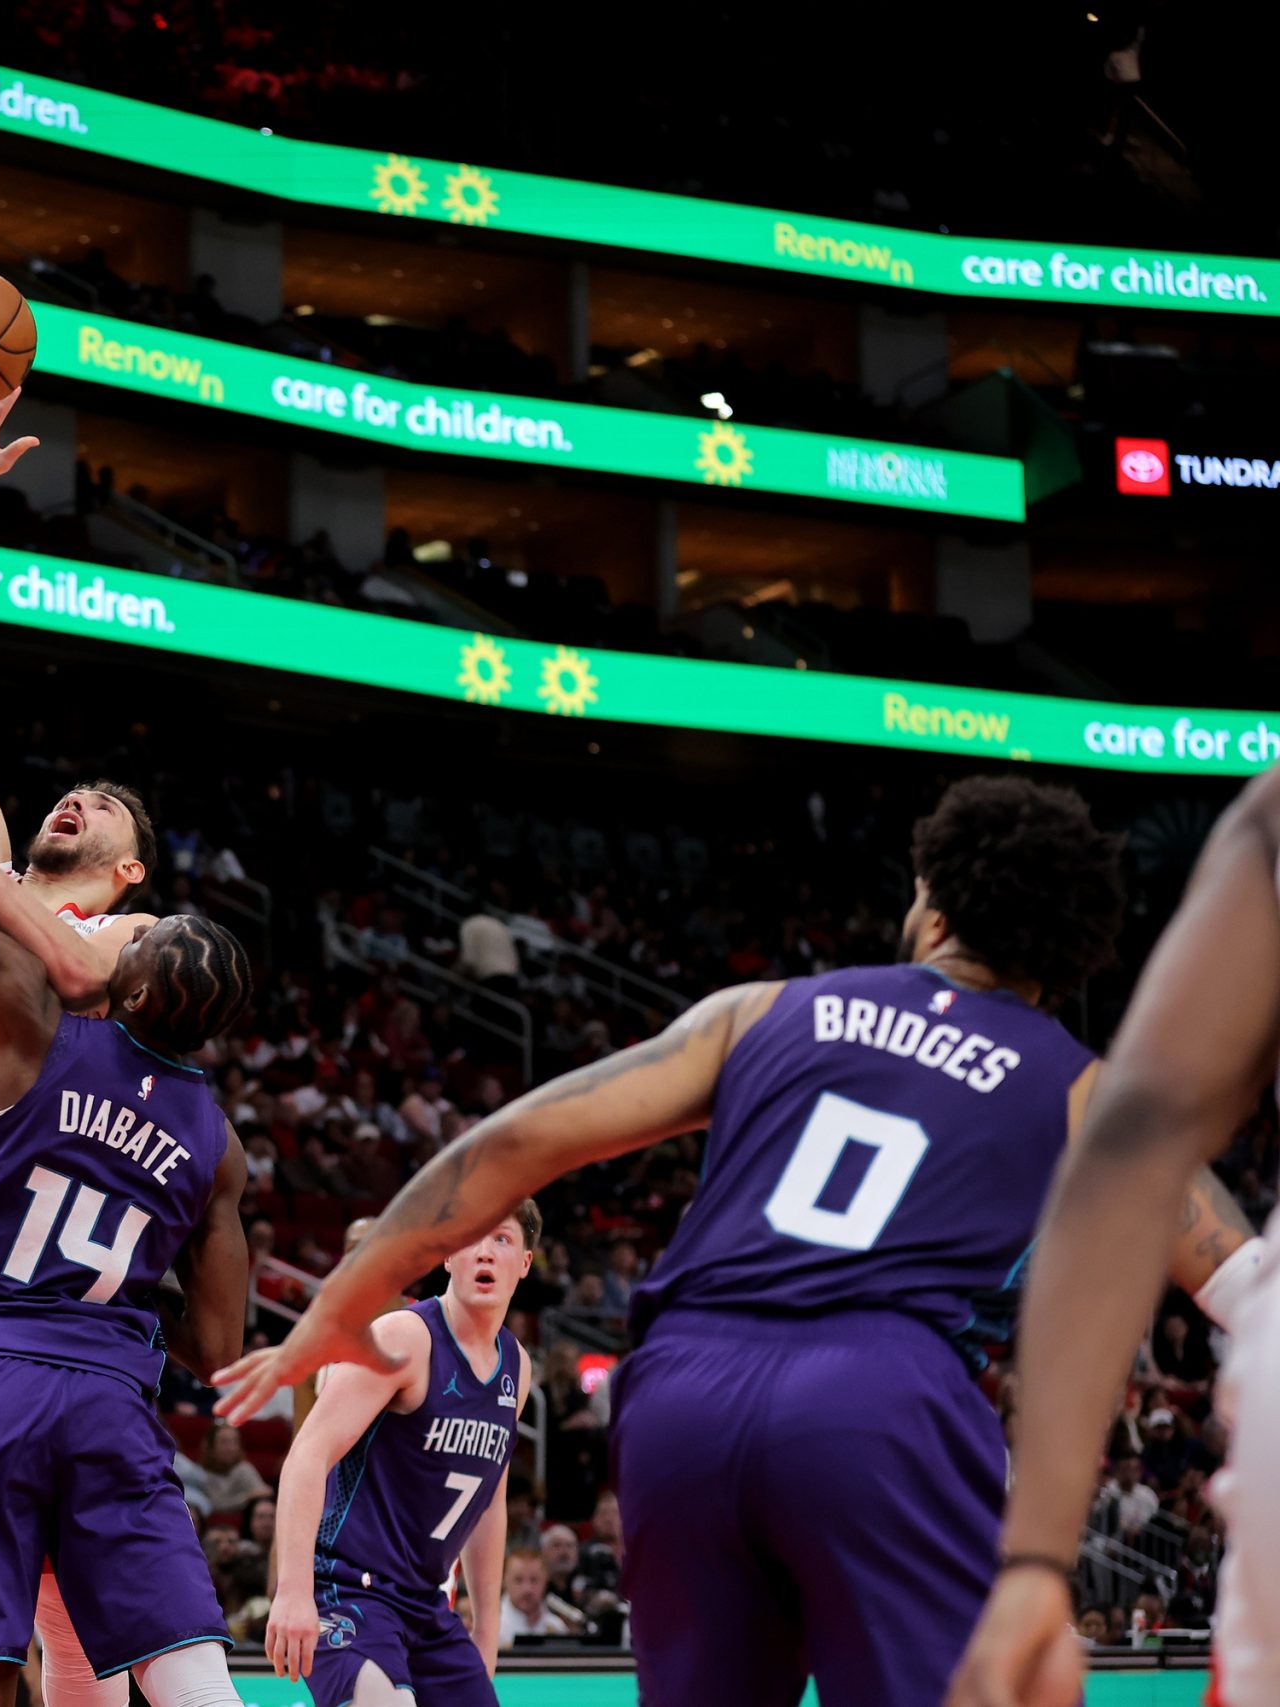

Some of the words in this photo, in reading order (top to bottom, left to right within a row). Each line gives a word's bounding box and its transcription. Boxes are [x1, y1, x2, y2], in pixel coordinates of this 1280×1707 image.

[961, 255, 1043, 287] care
[1049, 251, 1105, 291] for
[1110, 257, 1268, 303] children.
[271, 376, 346, 418] care
[351, 382, 402, 428] for
[405, 396, 573, 452] children.
[8, 565, 176, 634] children.
[1083, 721, 1166, 759] care
[1172, 717, 1231, 761] for
[813, 994, 1022, 1094] BRIDGES
[59, 1089, 192, 1187] DIABATE
[763, 1090, 932, 1251] 0
[1, 1163, 152, 1306] 14
[423, 1417, 511, 1467] HORNETS
[429, 1471, 484, 1541] 7
